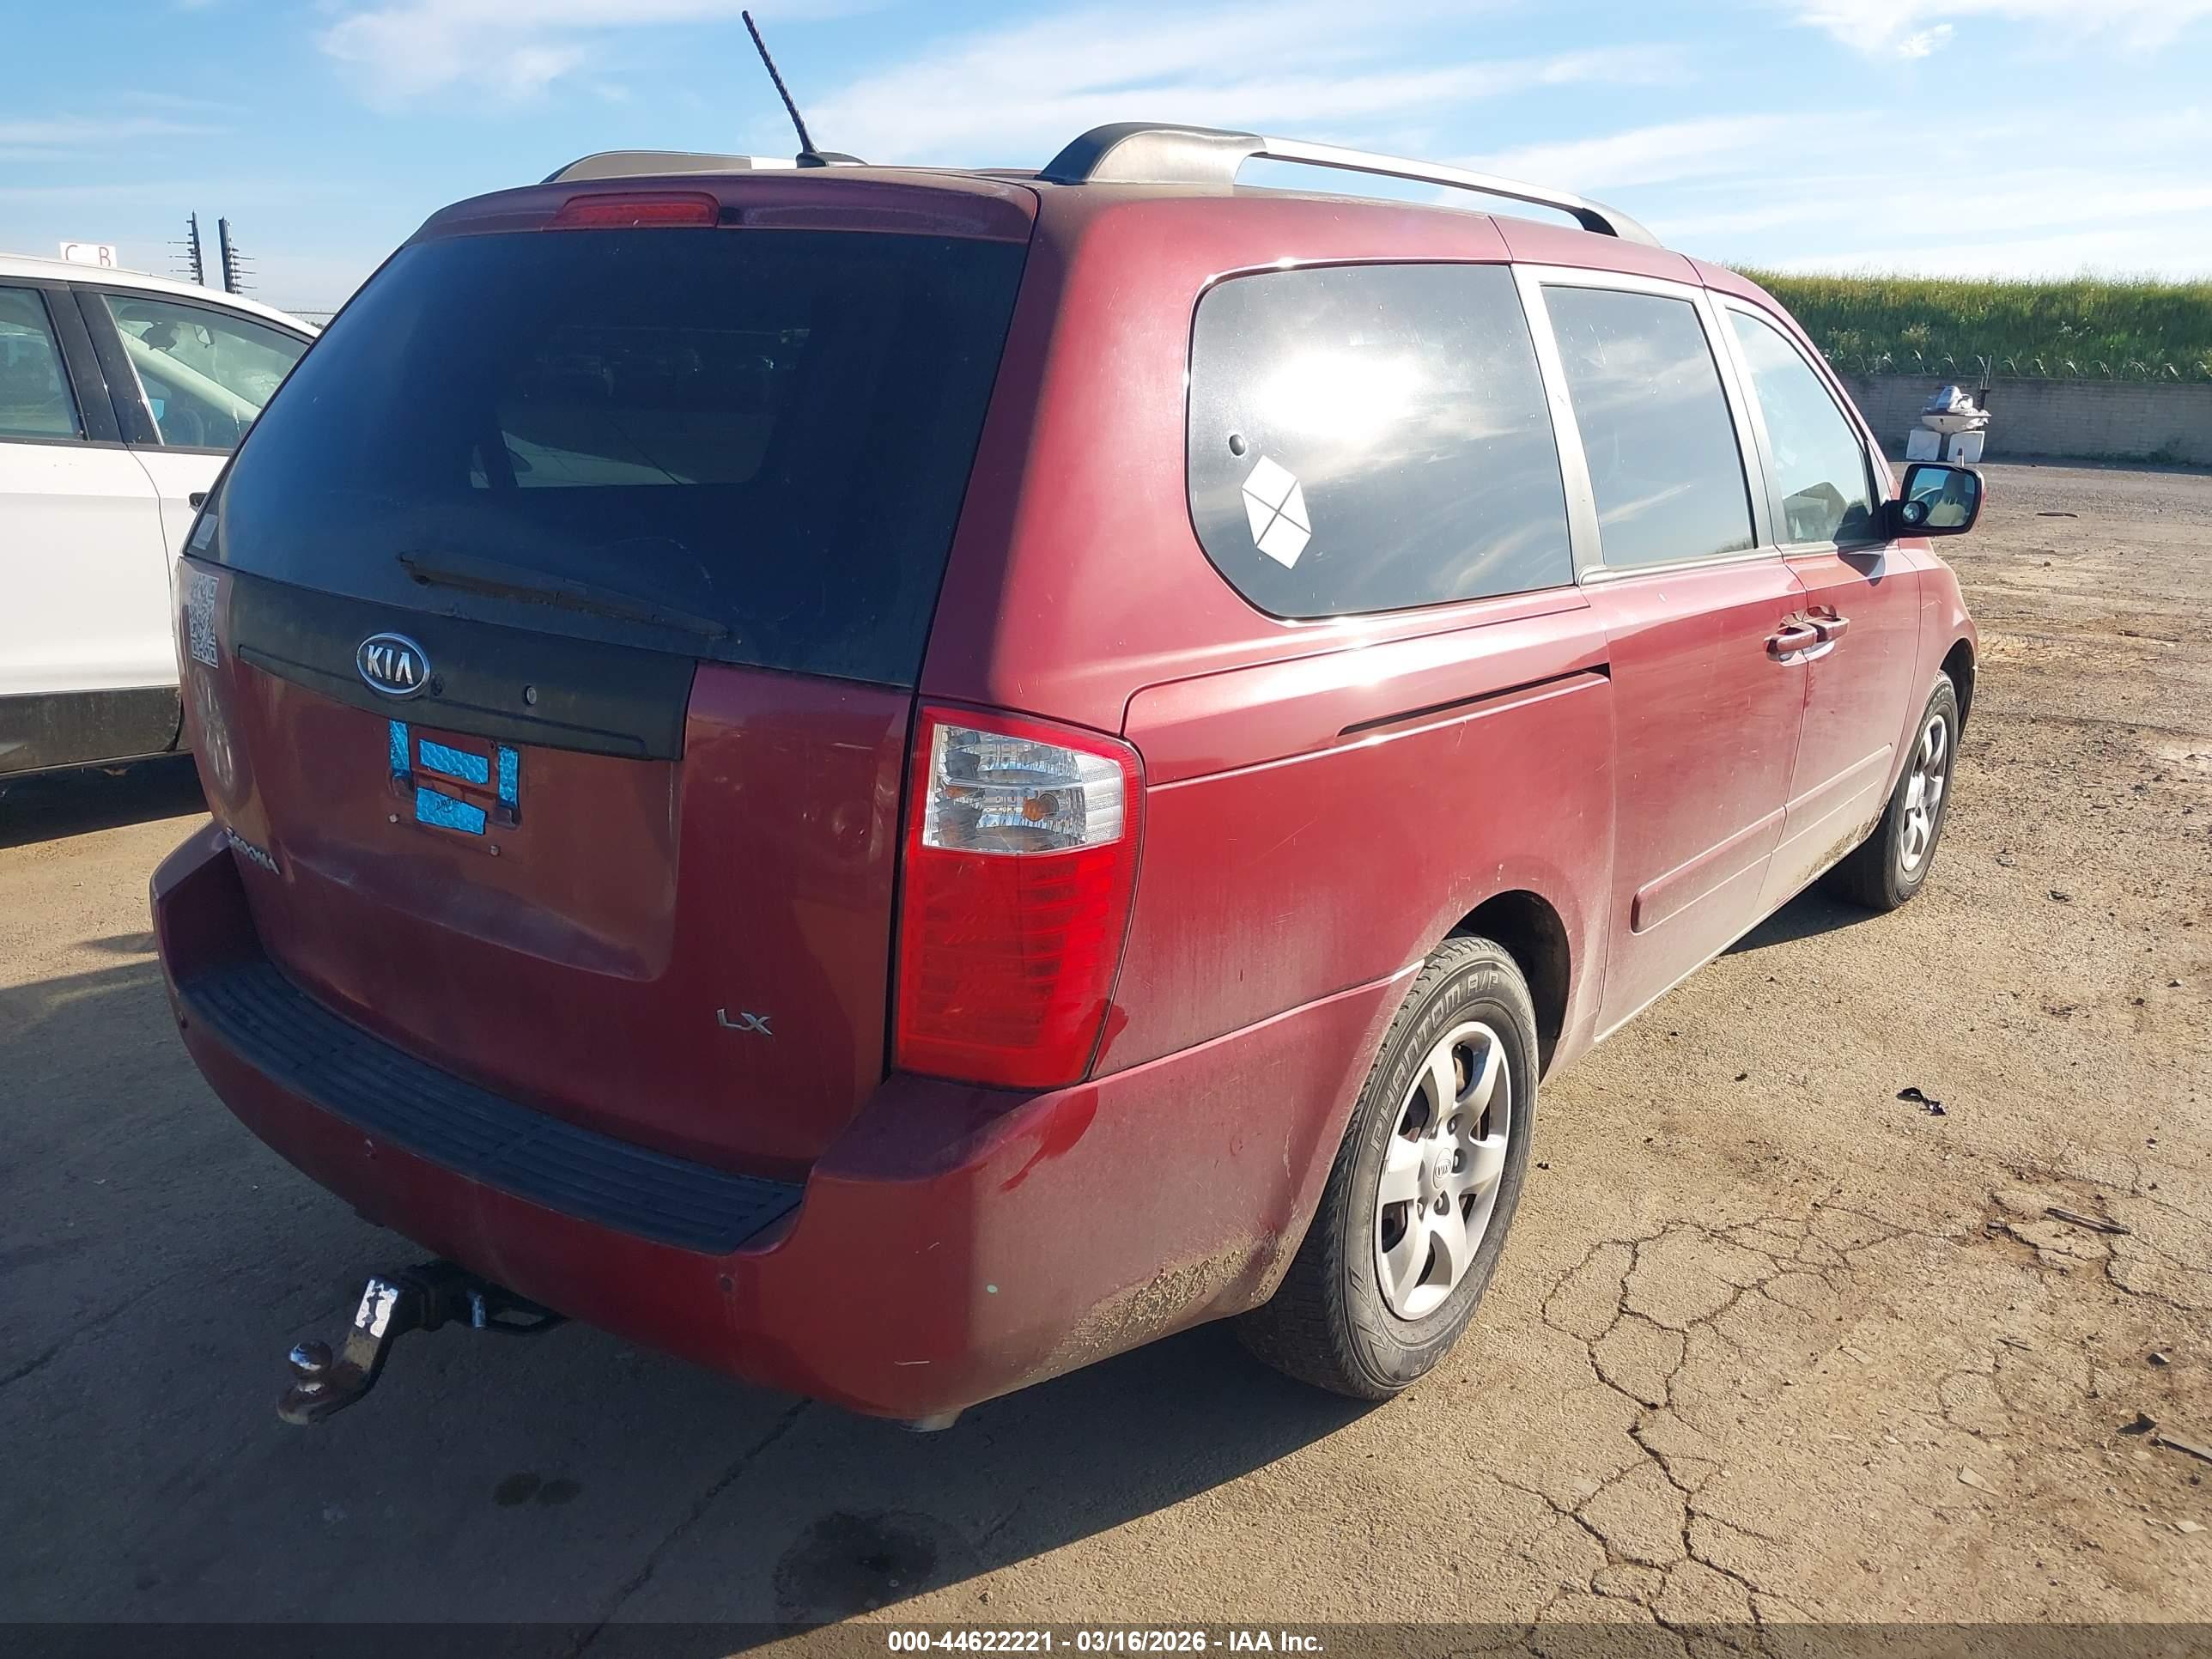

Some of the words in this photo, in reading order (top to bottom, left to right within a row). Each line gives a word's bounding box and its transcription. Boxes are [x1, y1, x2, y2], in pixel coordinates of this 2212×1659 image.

[367, 645, 414, 684] KIA
[716, 1008, 774, 1036] LX
[1370, 982, 1461, 1154] PHANTOM
[1467, 970, 1501, 996] A/P
